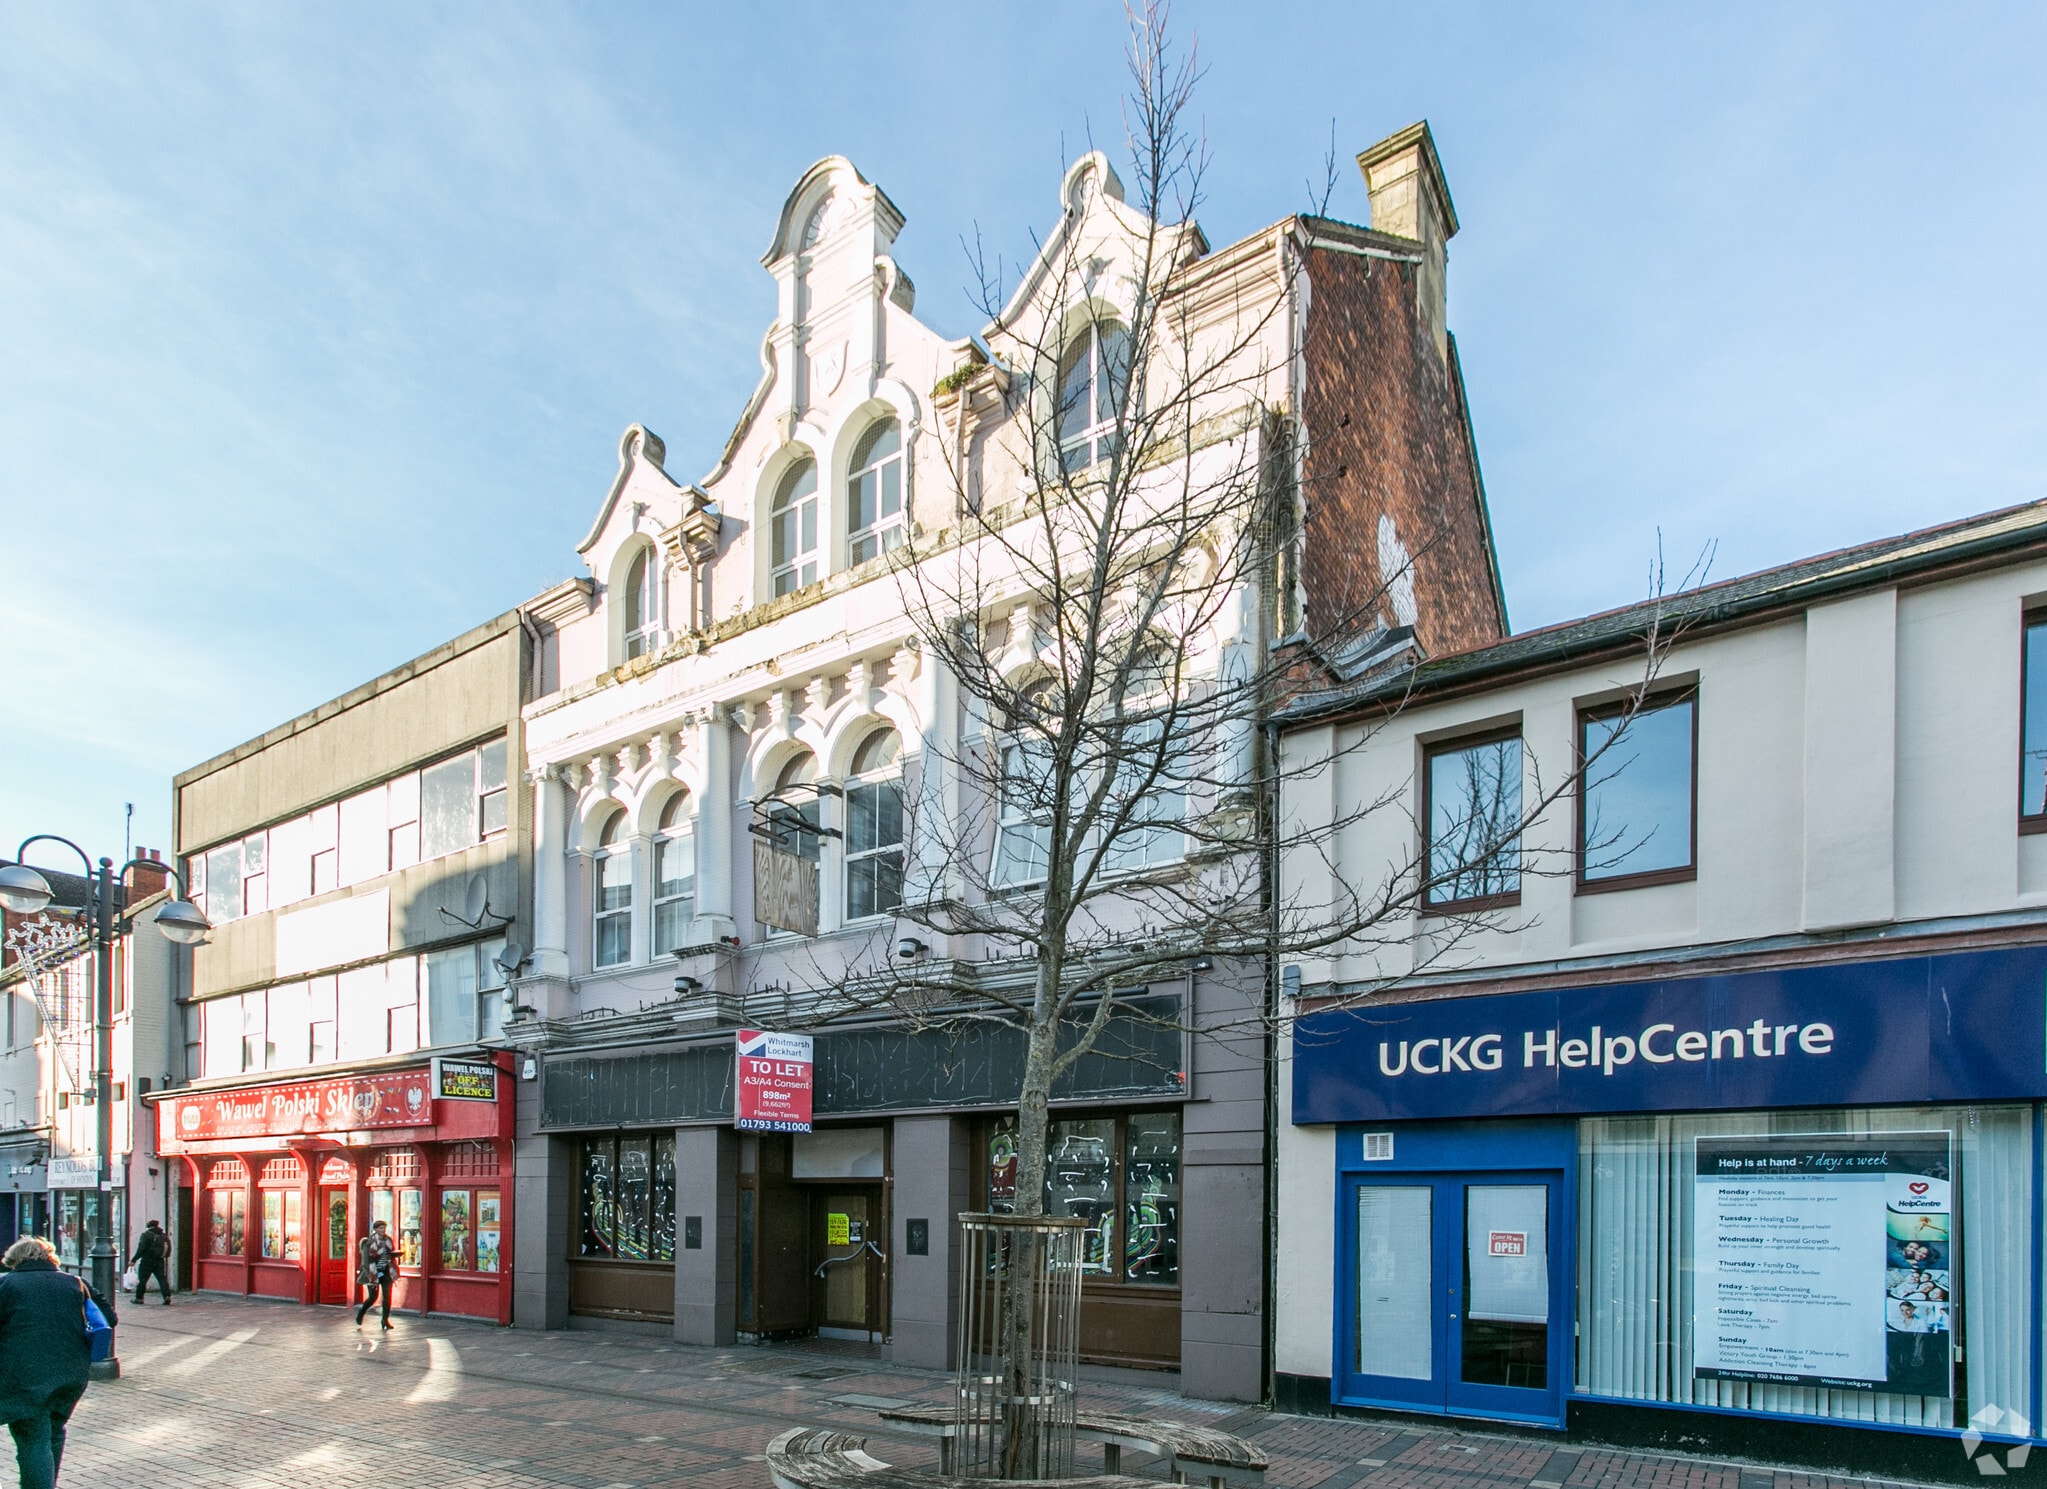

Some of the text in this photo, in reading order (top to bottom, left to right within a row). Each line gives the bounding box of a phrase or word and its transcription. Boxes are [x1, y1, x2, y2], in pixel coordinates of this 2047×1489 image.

[768, 1037, 810, 1048] Whitmarsh
[1378, 1018, 1834, 1076] UCKG HelpCentre
[767, 1047, 802, 1057] Lockhart
[442, 1063, 493, 1075] WAWEL POLSKI
[750, 1061, 804, 1077] TO LET
[457, 1076, 479, 1085] OFF
[744, 1076, 809, 1089] A3/A4 Consent
[445, 1085, 492, 1097] LICENCE
[216, 1086, 374, 1121] Wawel Polski Sklep
[753, 1109, 779, 1117] Flexible
[740, 1119, 810, 1132] 01793 541000
[1719, 1158, 1742, 1169] Help
[1745, 1158, 1754, 1167] is
[1756, 1158, 1767, 1167] at
[1769, 1157, 1797, 1166] hand
[1805, 1155, 1814, 1166] 7
[1815, 1153, 1843, 1171] days
[1846, 1157, 1854, 1166] a
[1856, 1152, 1888, 1166] week
[1718, 1236, 1764, 1244] Wednesday
[1494, 1242, 1520, 1253] OPEN
[1719, 1260, 1755, 1268] Thursday
[1718, 1308, 1753, 1316] Saturday
[1719, 1336, 1747, 1344] Sunday
